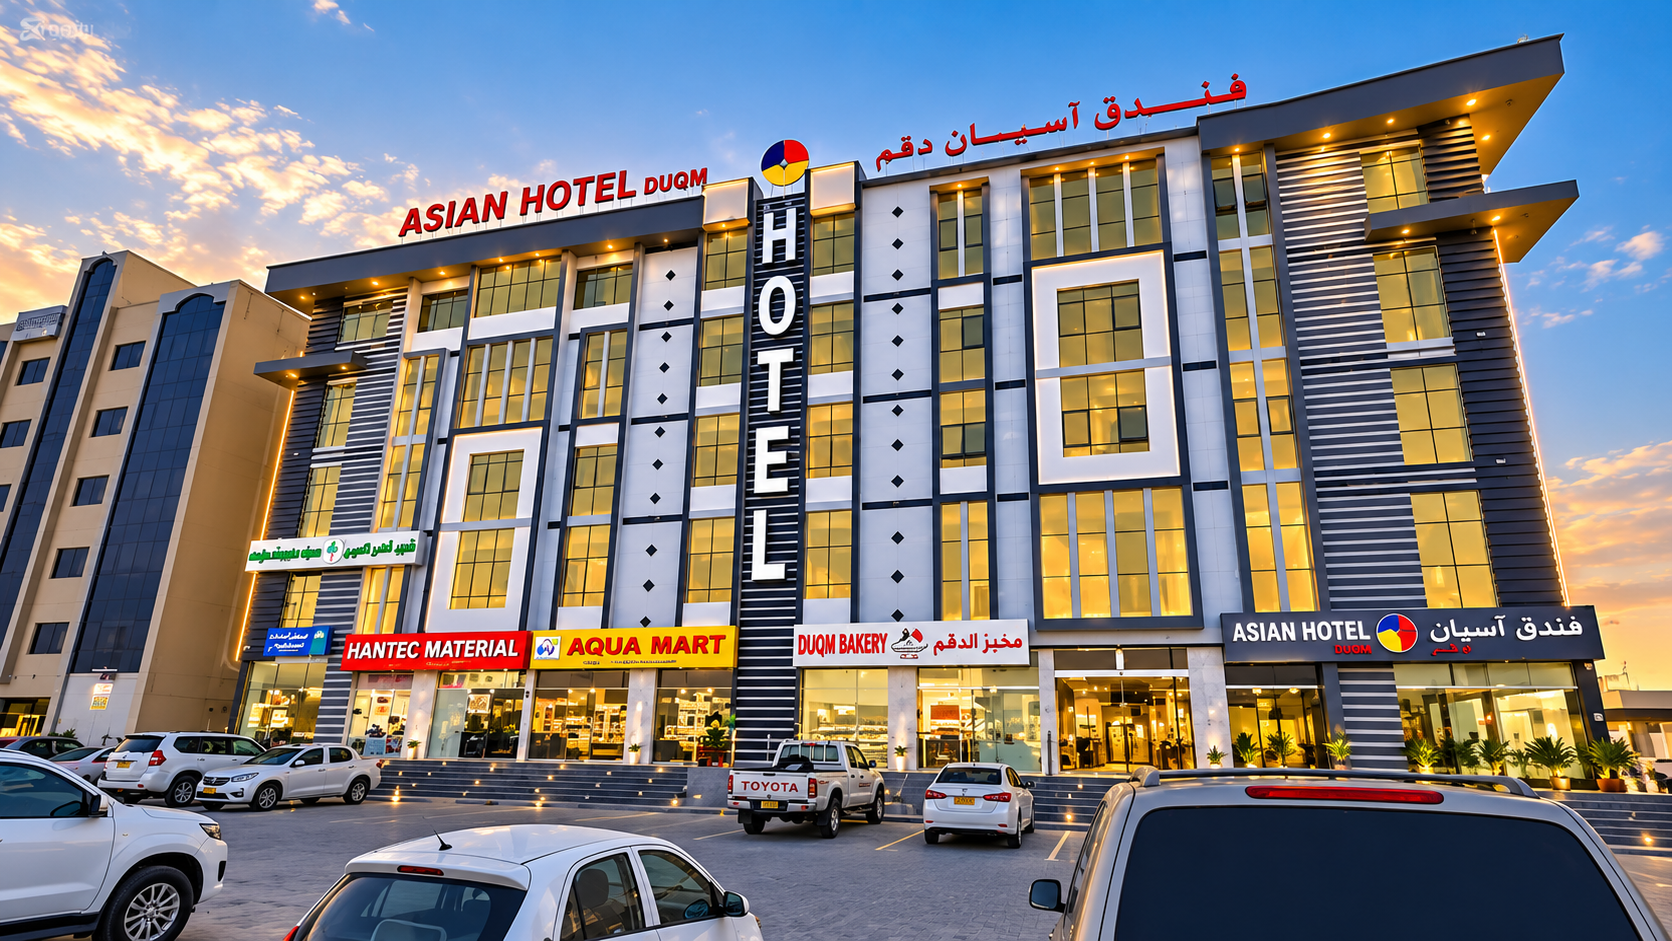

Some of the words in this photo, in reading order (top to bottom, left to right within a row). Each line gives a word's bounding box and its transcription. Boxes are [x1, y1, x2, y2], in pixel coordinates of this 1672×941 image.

[1094, 73, 1247, 129] فندق
[945, 101, 1080, 156] آسيان
[875, 135, 933, 172] دقم
[398, 191, 508, 237] ASIAN
[519, 169, 637, 216] HOTEL
[643, 167, 708, 196] DUQM
[751, 207, 797, 581] HOTEL
[1232, 621, 1297, 643] ASIAN
[1301, 620, 1371, 642] HOTEL
[1429, 614, 1506, 644] آسيان
[1516, 615, 1584, 641] فندق
[347, 640, 421, 660] HANTEC
[424, 639, 519, 658] MATERIAL
[566, 636, 642, 657] AQUA
[650, 634, 727, 655] MART
[797, 633, 836, 657] DUQM
[838, 633, 888, 655] BAKERY
[933, 632, 978, 656] الدقم
[981, 632, 1024, 654] مخبز
[740, 781, 799, 793] TOYOTA
